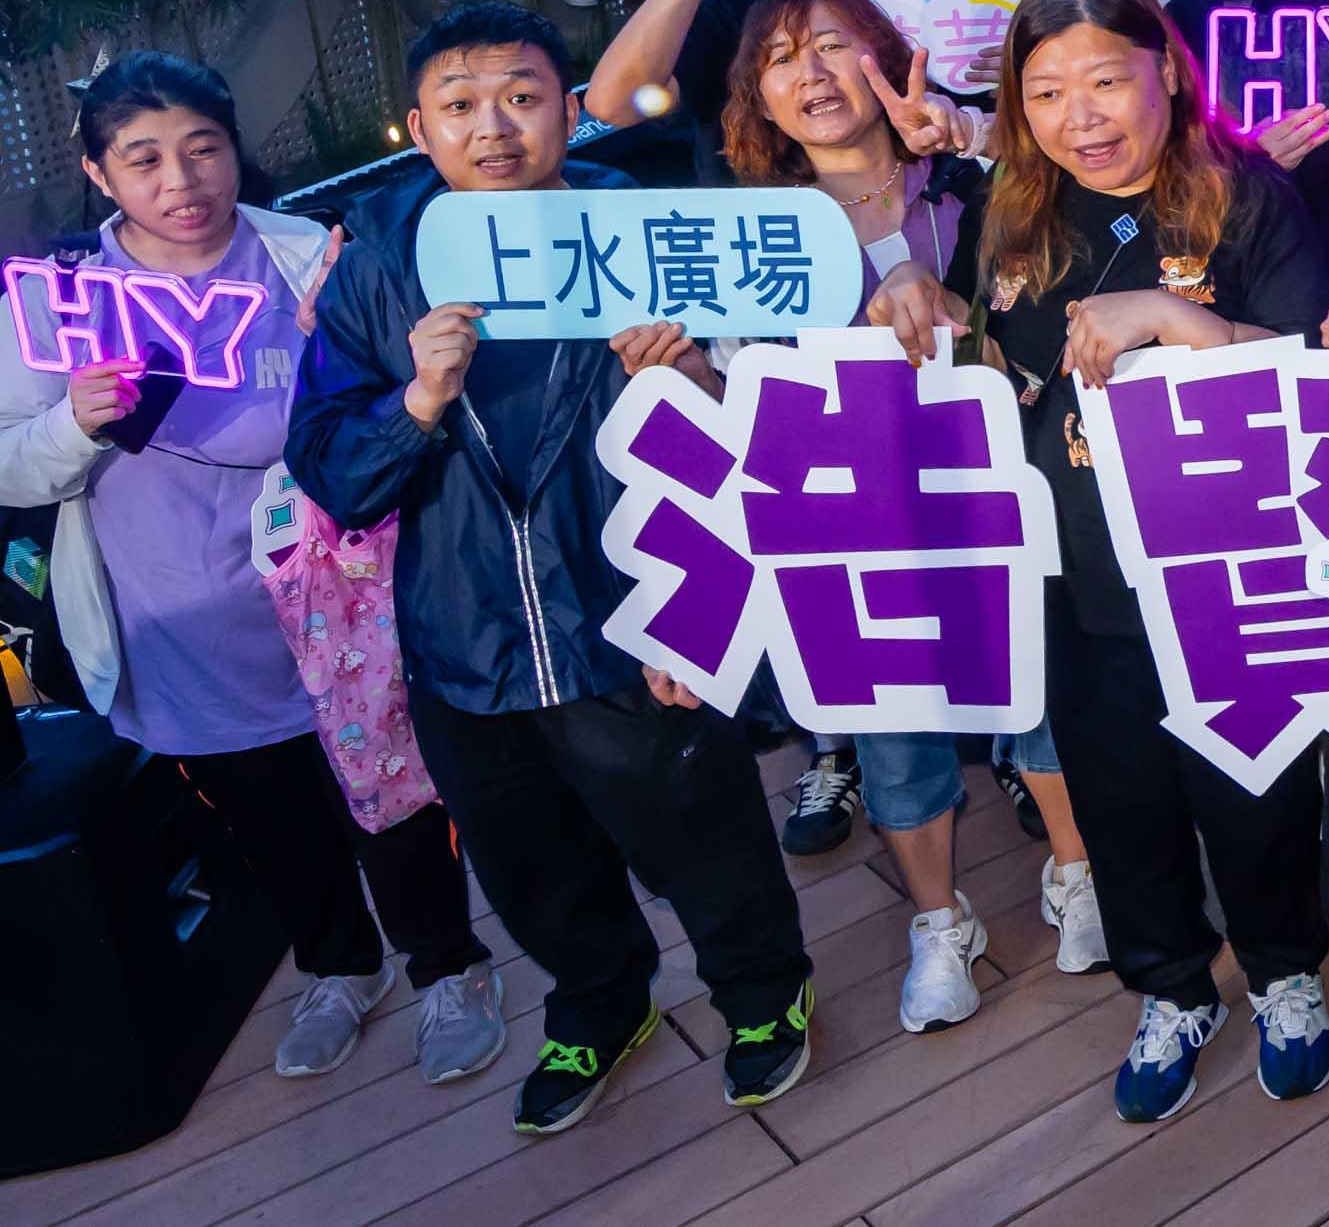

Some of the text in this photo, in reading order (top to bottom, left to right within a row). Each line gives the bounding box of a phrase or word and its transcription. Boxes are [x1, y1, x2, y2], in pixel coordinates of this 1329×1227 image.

[474, 208, 814, 318] 上水廣場
[2, 257, 269, 389] HY
[255, 348, 292, 390] HY
